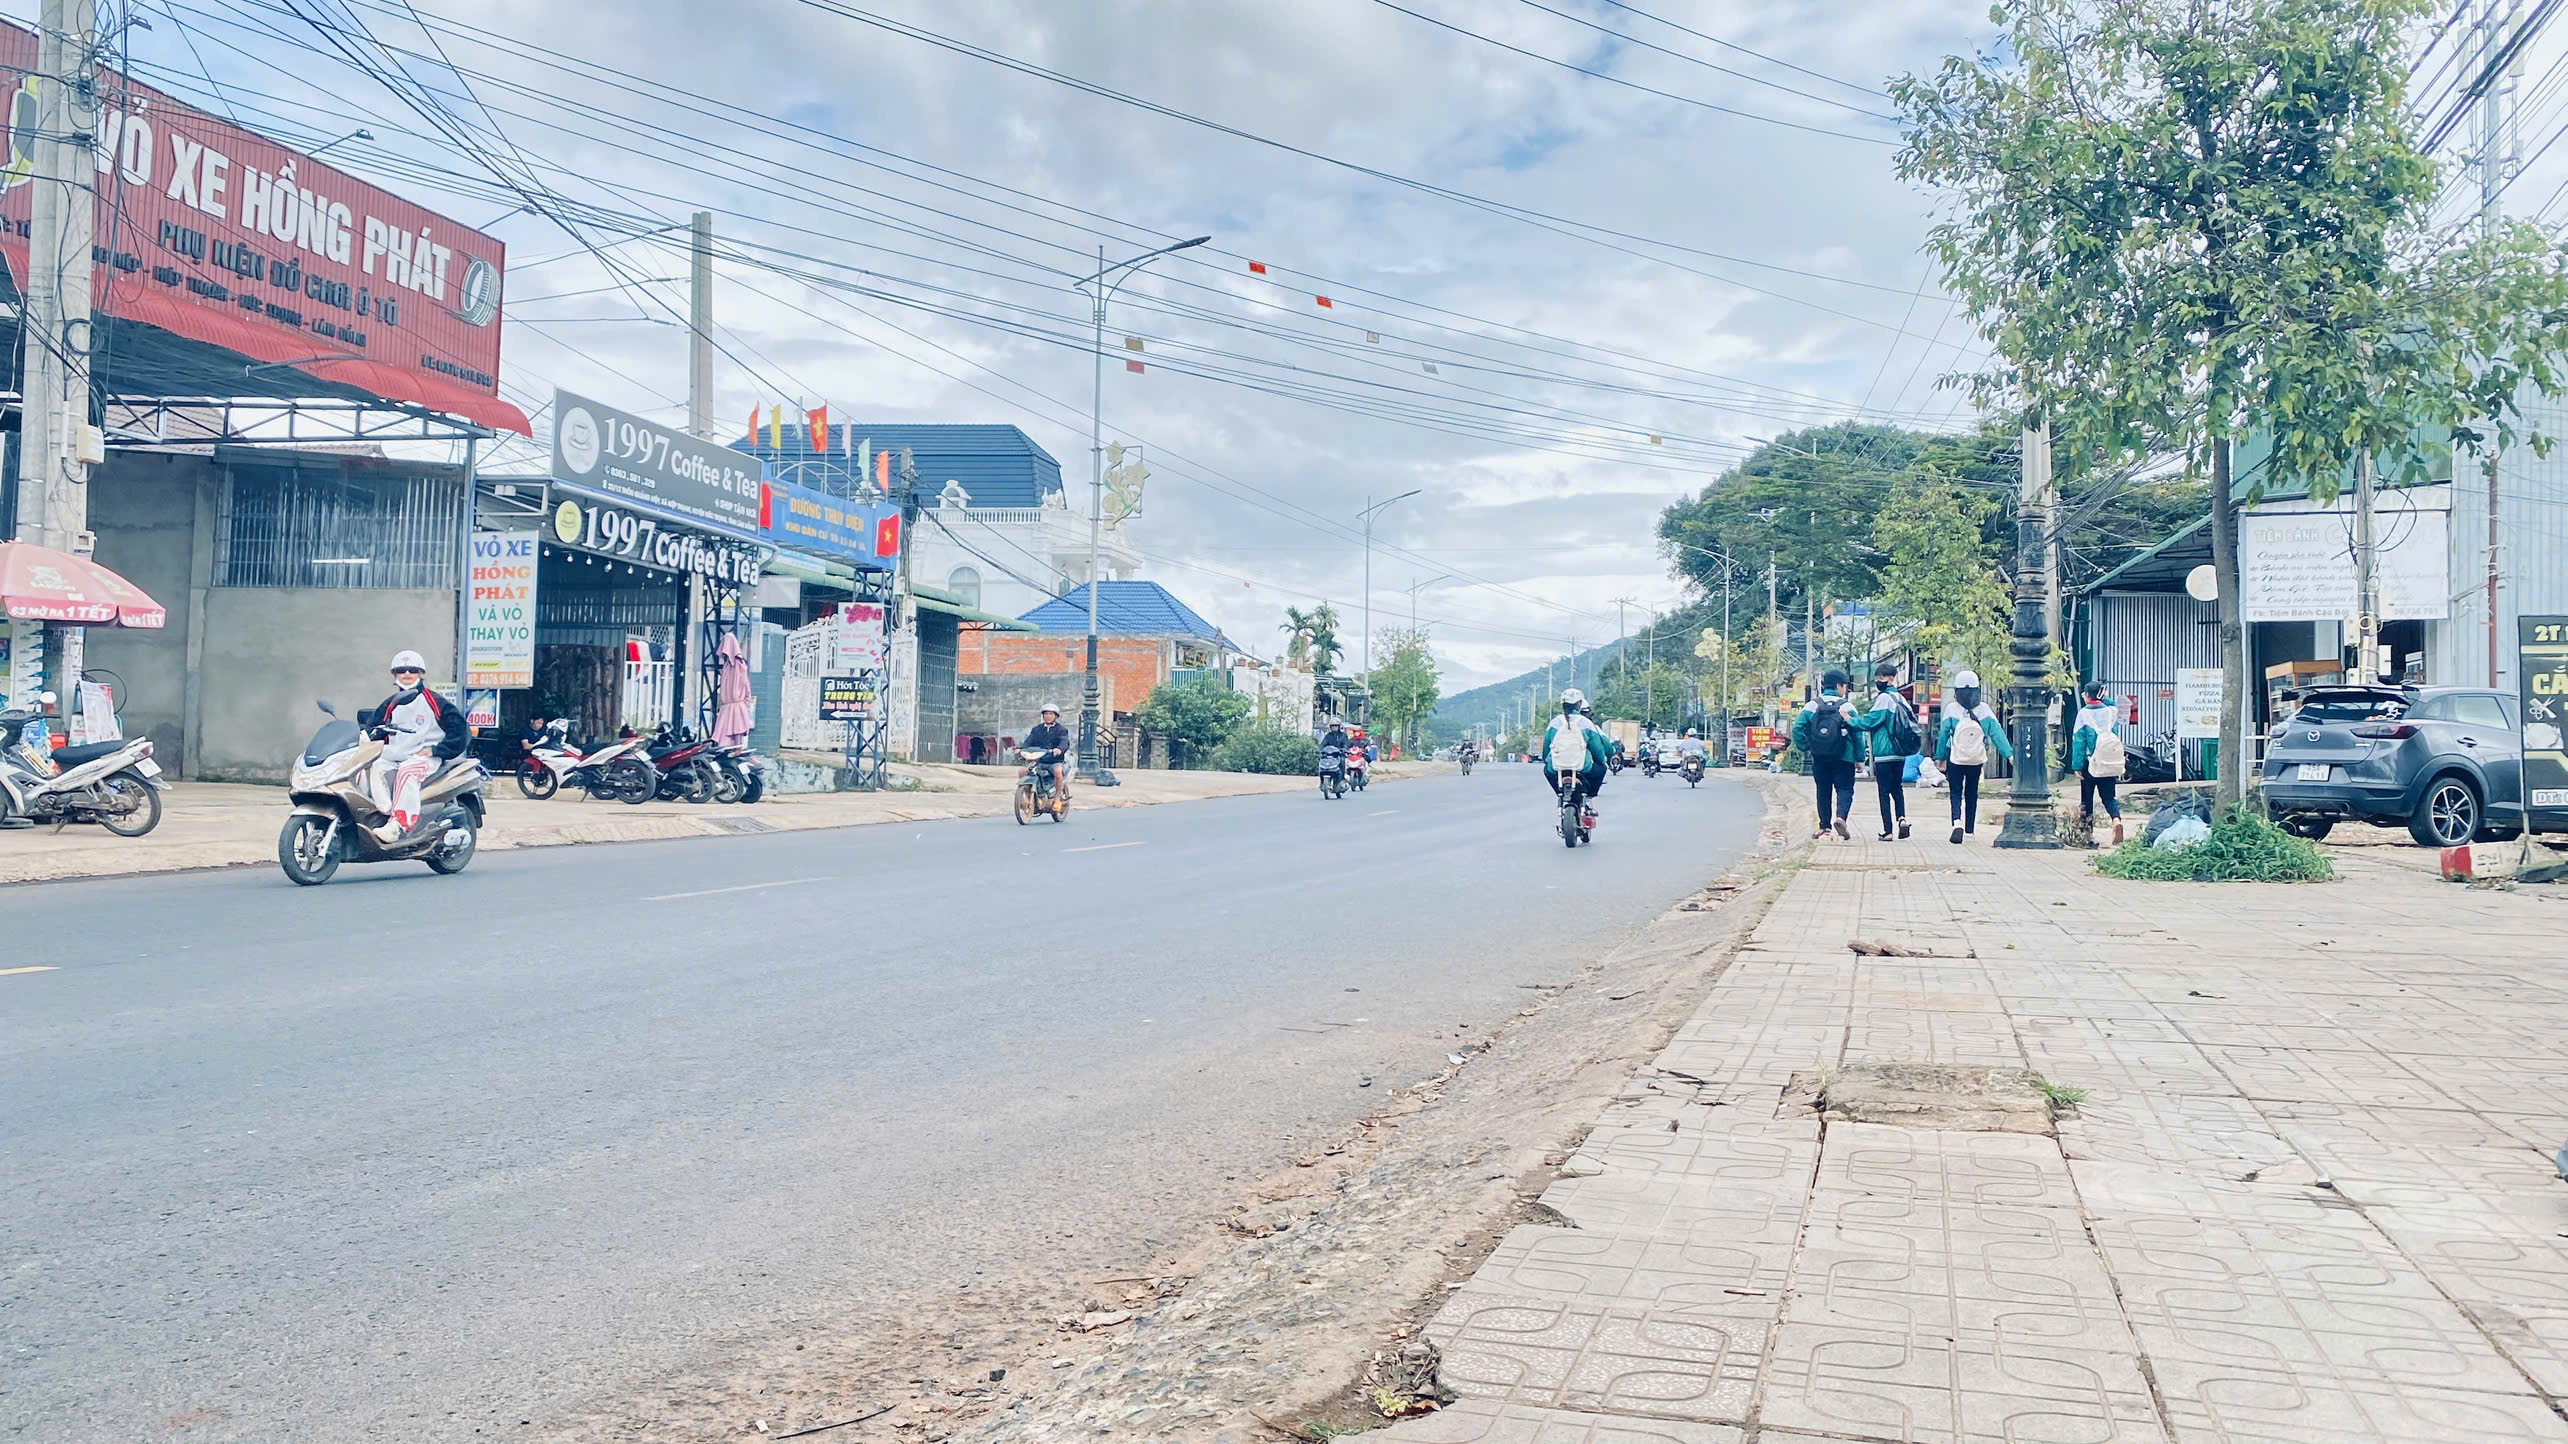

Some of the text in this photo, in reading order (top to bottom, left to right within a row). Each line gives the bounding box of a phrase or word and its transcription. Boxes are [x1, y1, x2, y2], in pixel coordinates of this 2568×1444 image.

[94, 97, 451, 302] VỎ XE HỒNG PHÁT
[159, 219, 206, 265] PHỤ
[213, 238, 265, 281] KIỆN
[603, 417, 670, 472] 1997
[671, 450, 720, 488] Coffee
[722, 467, 733, 492] &
[734, 470, 758, 500] Tea
[473, 535, 532, 558] VỎ XE
[582, 506, 759, 586] 1997 Coffee & Tea
[472, 560, 531, 580] HỒNG
[473, 582, 529, 600] PHÁT
[77, 603, 112, 620] TẾT
[478, 602, 522, 621] VÁ VỎ
[470, 622, 529, 641] THAY VỎ
[2534, 625, 2562, 641] 2T
[467, 713, 494, 725] 400K
